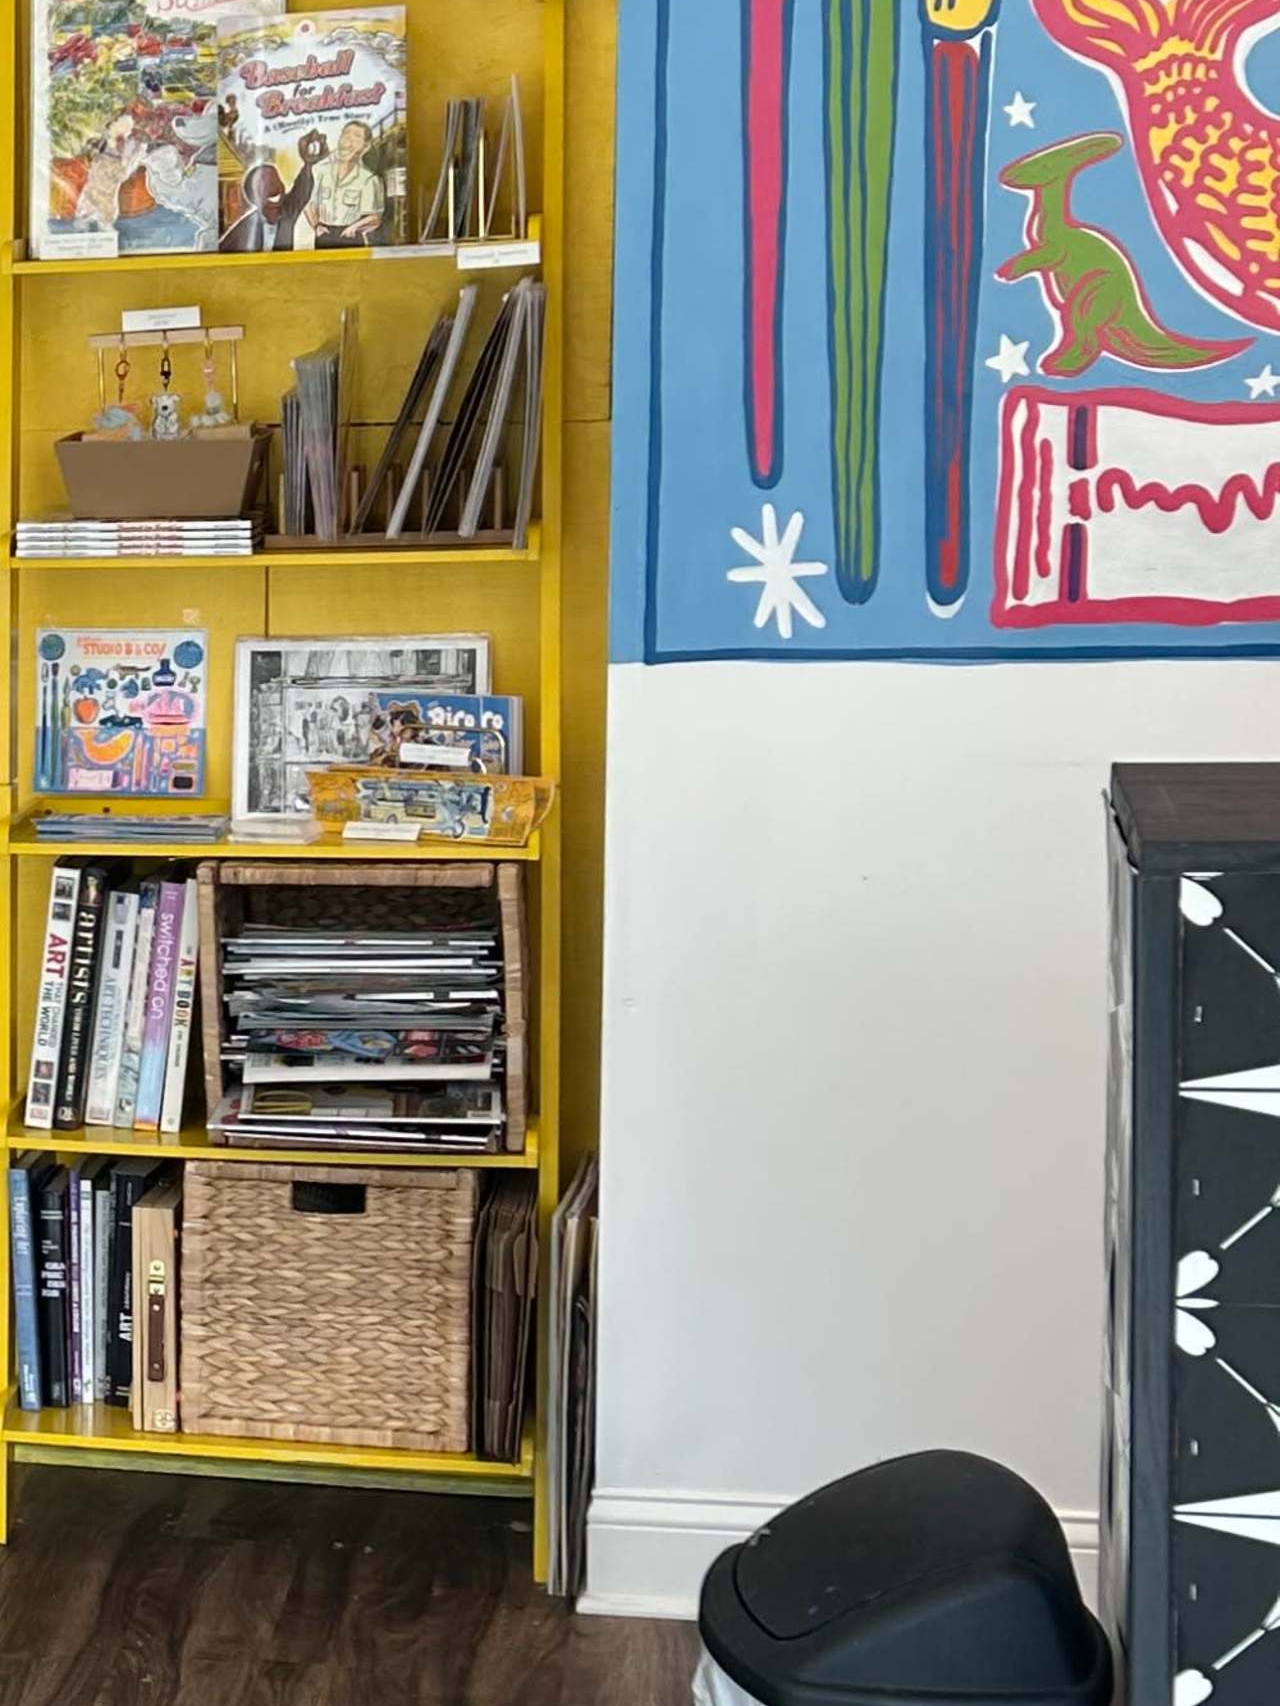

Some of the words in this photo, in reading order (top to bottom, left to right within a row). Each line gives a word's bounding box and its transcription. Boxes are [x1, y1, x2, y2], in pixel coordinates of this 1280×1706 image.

[240, 48, 356, 90] Baseball
[256, 81, 387, 119] Breakfast
[292, 83, 317, 98] for
[45, 933, 68, 979] ART
[72, 911, 96, 1004] artists
[153, 912, 175, 991] switched
[178, 958, 195, 986] ART
[42, 981, 54, 1002] THE
[150, 997, 165, 1020] on
[173, 990, 191, 1028] BOOK
[38, 1007, 51, 1047] WORLD
